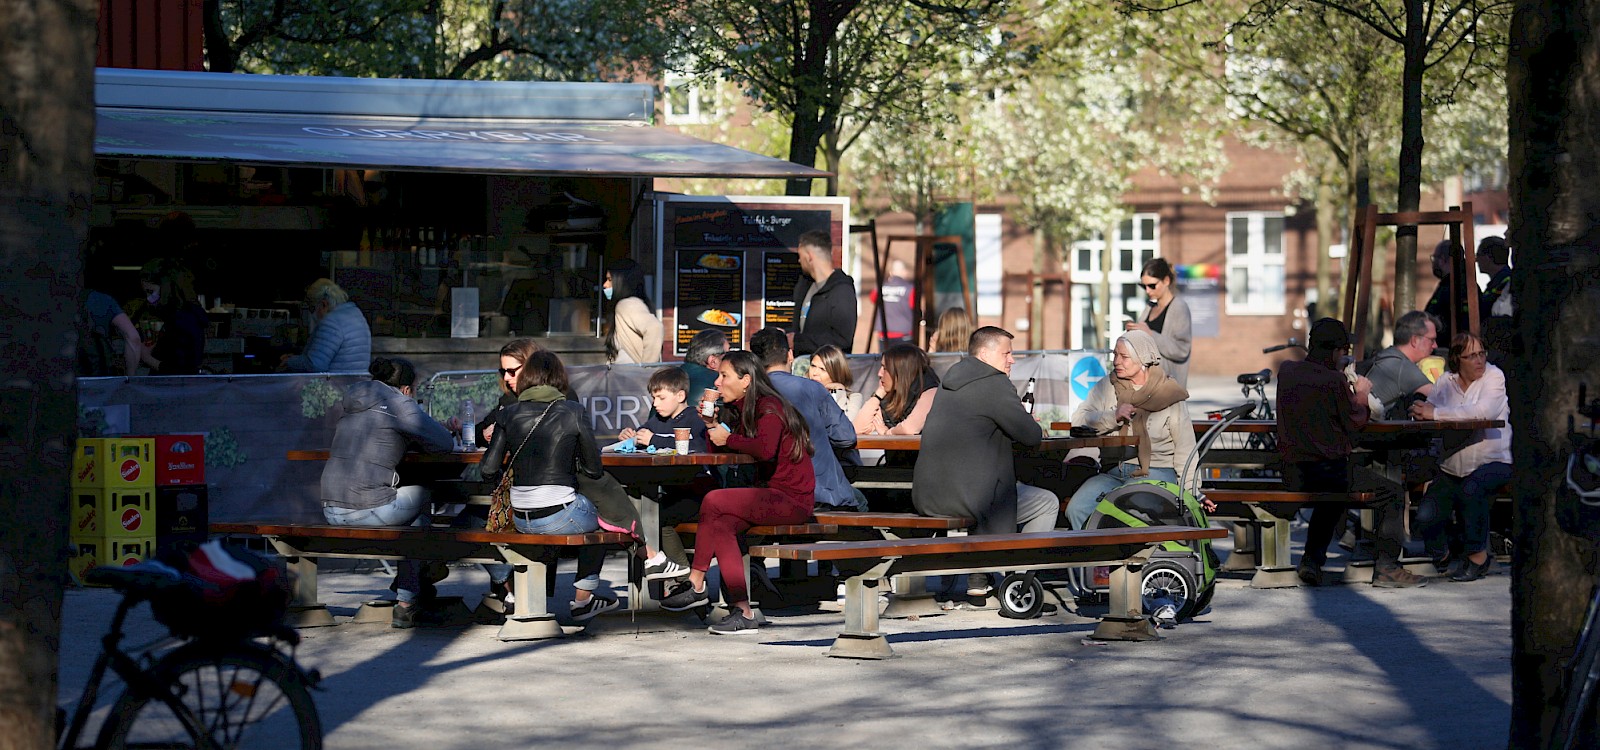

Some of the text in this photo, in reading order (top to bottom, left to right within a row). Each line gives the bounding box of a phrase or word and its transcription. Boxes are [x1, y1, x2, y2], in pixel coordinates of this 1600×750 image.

[302, 126, 603, 142] CURRYBAR
[582, 395, 653, 430] RR
[122, 464, 141, 478] Sinalco
[123, 514, 142, 529] Sinalco
